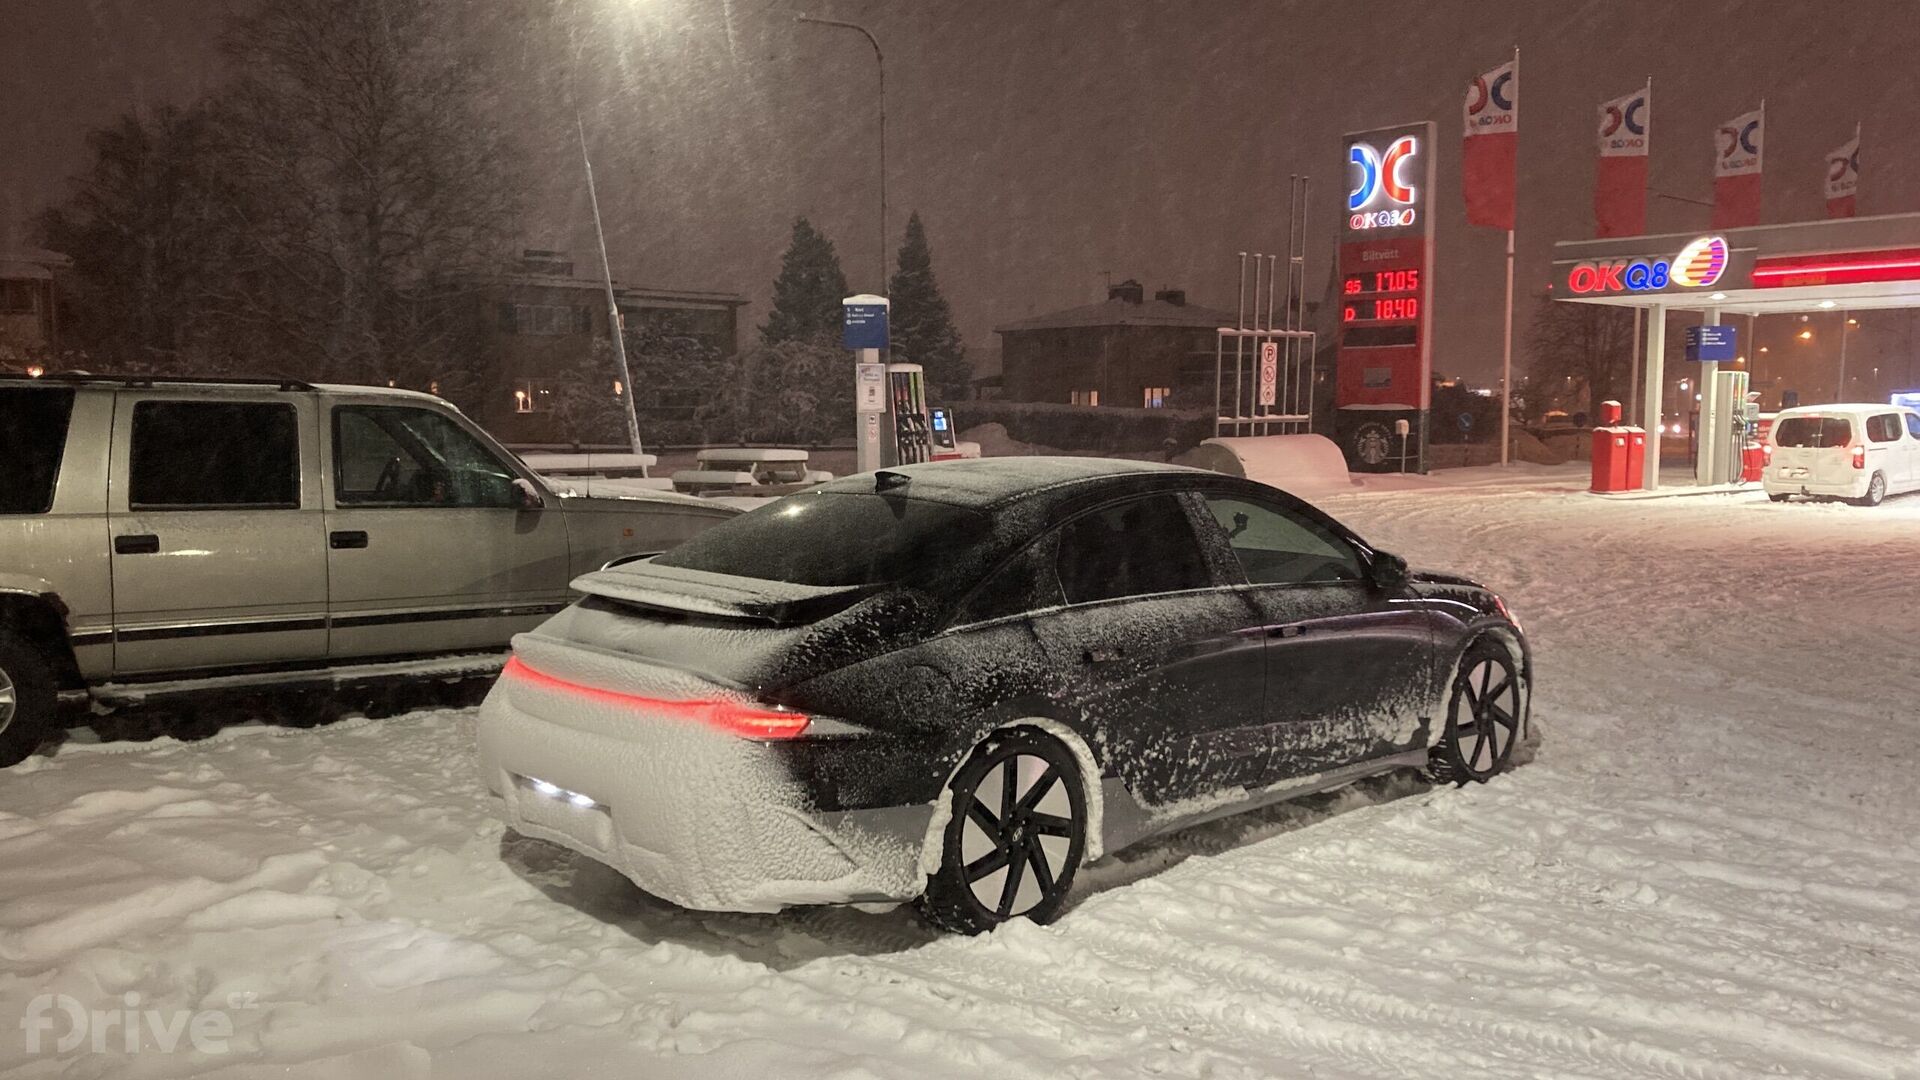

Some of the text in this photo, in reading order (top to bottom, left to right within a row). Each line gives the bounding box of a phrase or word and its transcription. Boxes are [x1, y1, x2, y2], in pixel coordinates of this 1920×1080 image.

[1345, 280, 1361, 293] 95
[1569, 261, 1669, 293] OKQ8
[1344, 299, 1416, 320] D 18.40
